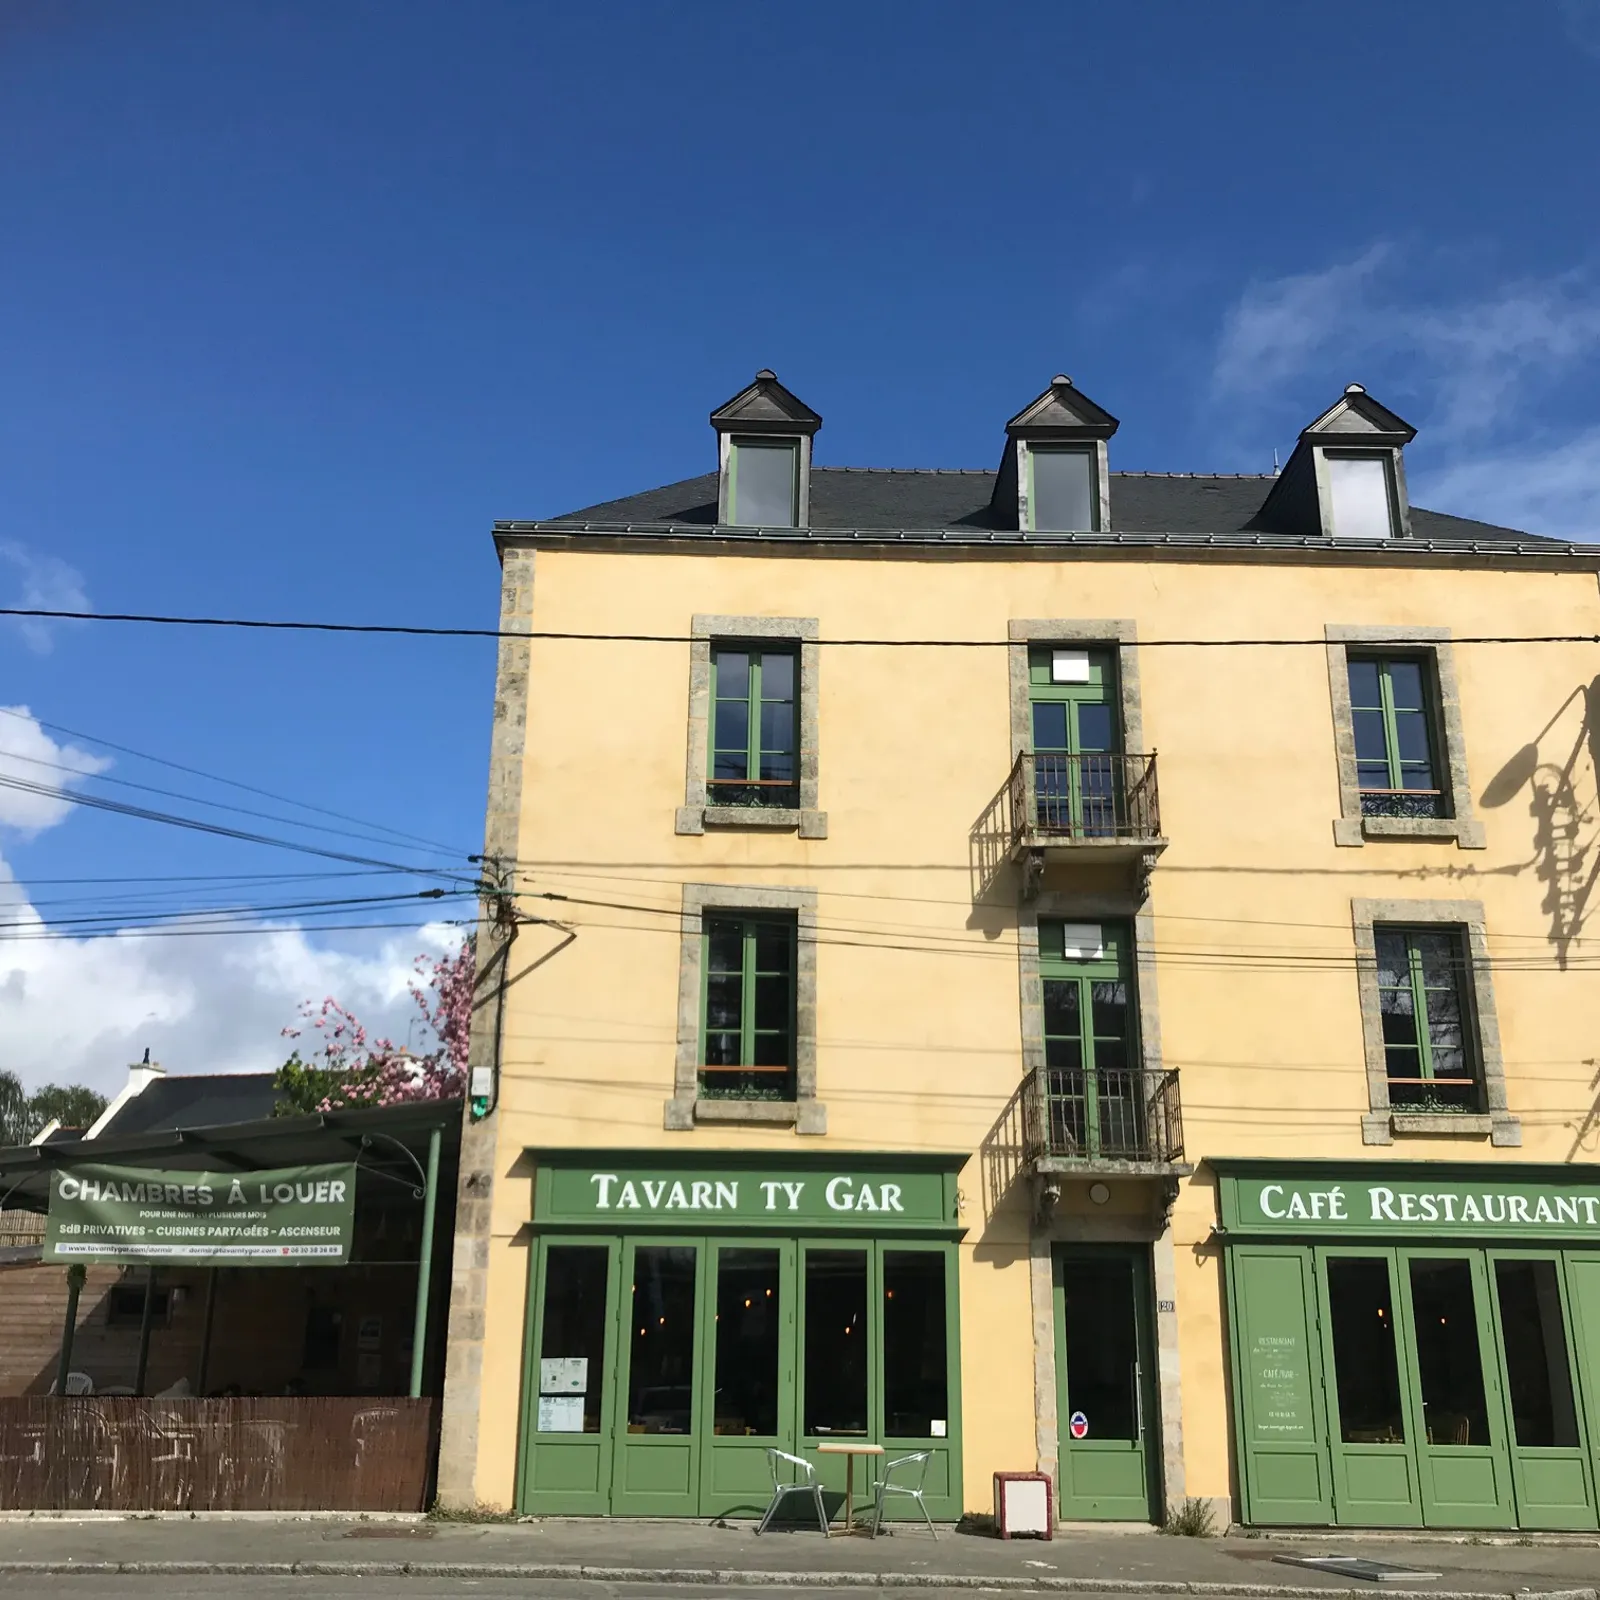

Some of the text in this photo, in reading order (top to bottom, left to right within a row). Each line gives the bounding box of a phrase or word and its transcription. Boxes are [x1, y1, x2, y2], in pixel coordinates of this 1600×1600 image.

[58, 1177, 346, 1205] CHAMBRES À LOUER
[590, 1174, 904, 1211] TAVARN TY GAR
[140, 1210, 161, 1218] POUR
[162, 1211, 177, 1219] UNE
[1260, 1185, 1600, 1224] CAFÉ RESTAURANT
[59, 1223, 82, 1234] SdB
[83, 1225, 146, 1236] PRIVATIVES
[156, 1226, 206, 1237] CUISINES
[207, 1224, 269, 1237] PARTAGÉES
[279, 1226, 341, 1237] ASCENSEUR
[1160, 1301, 1173, 1311] 20
